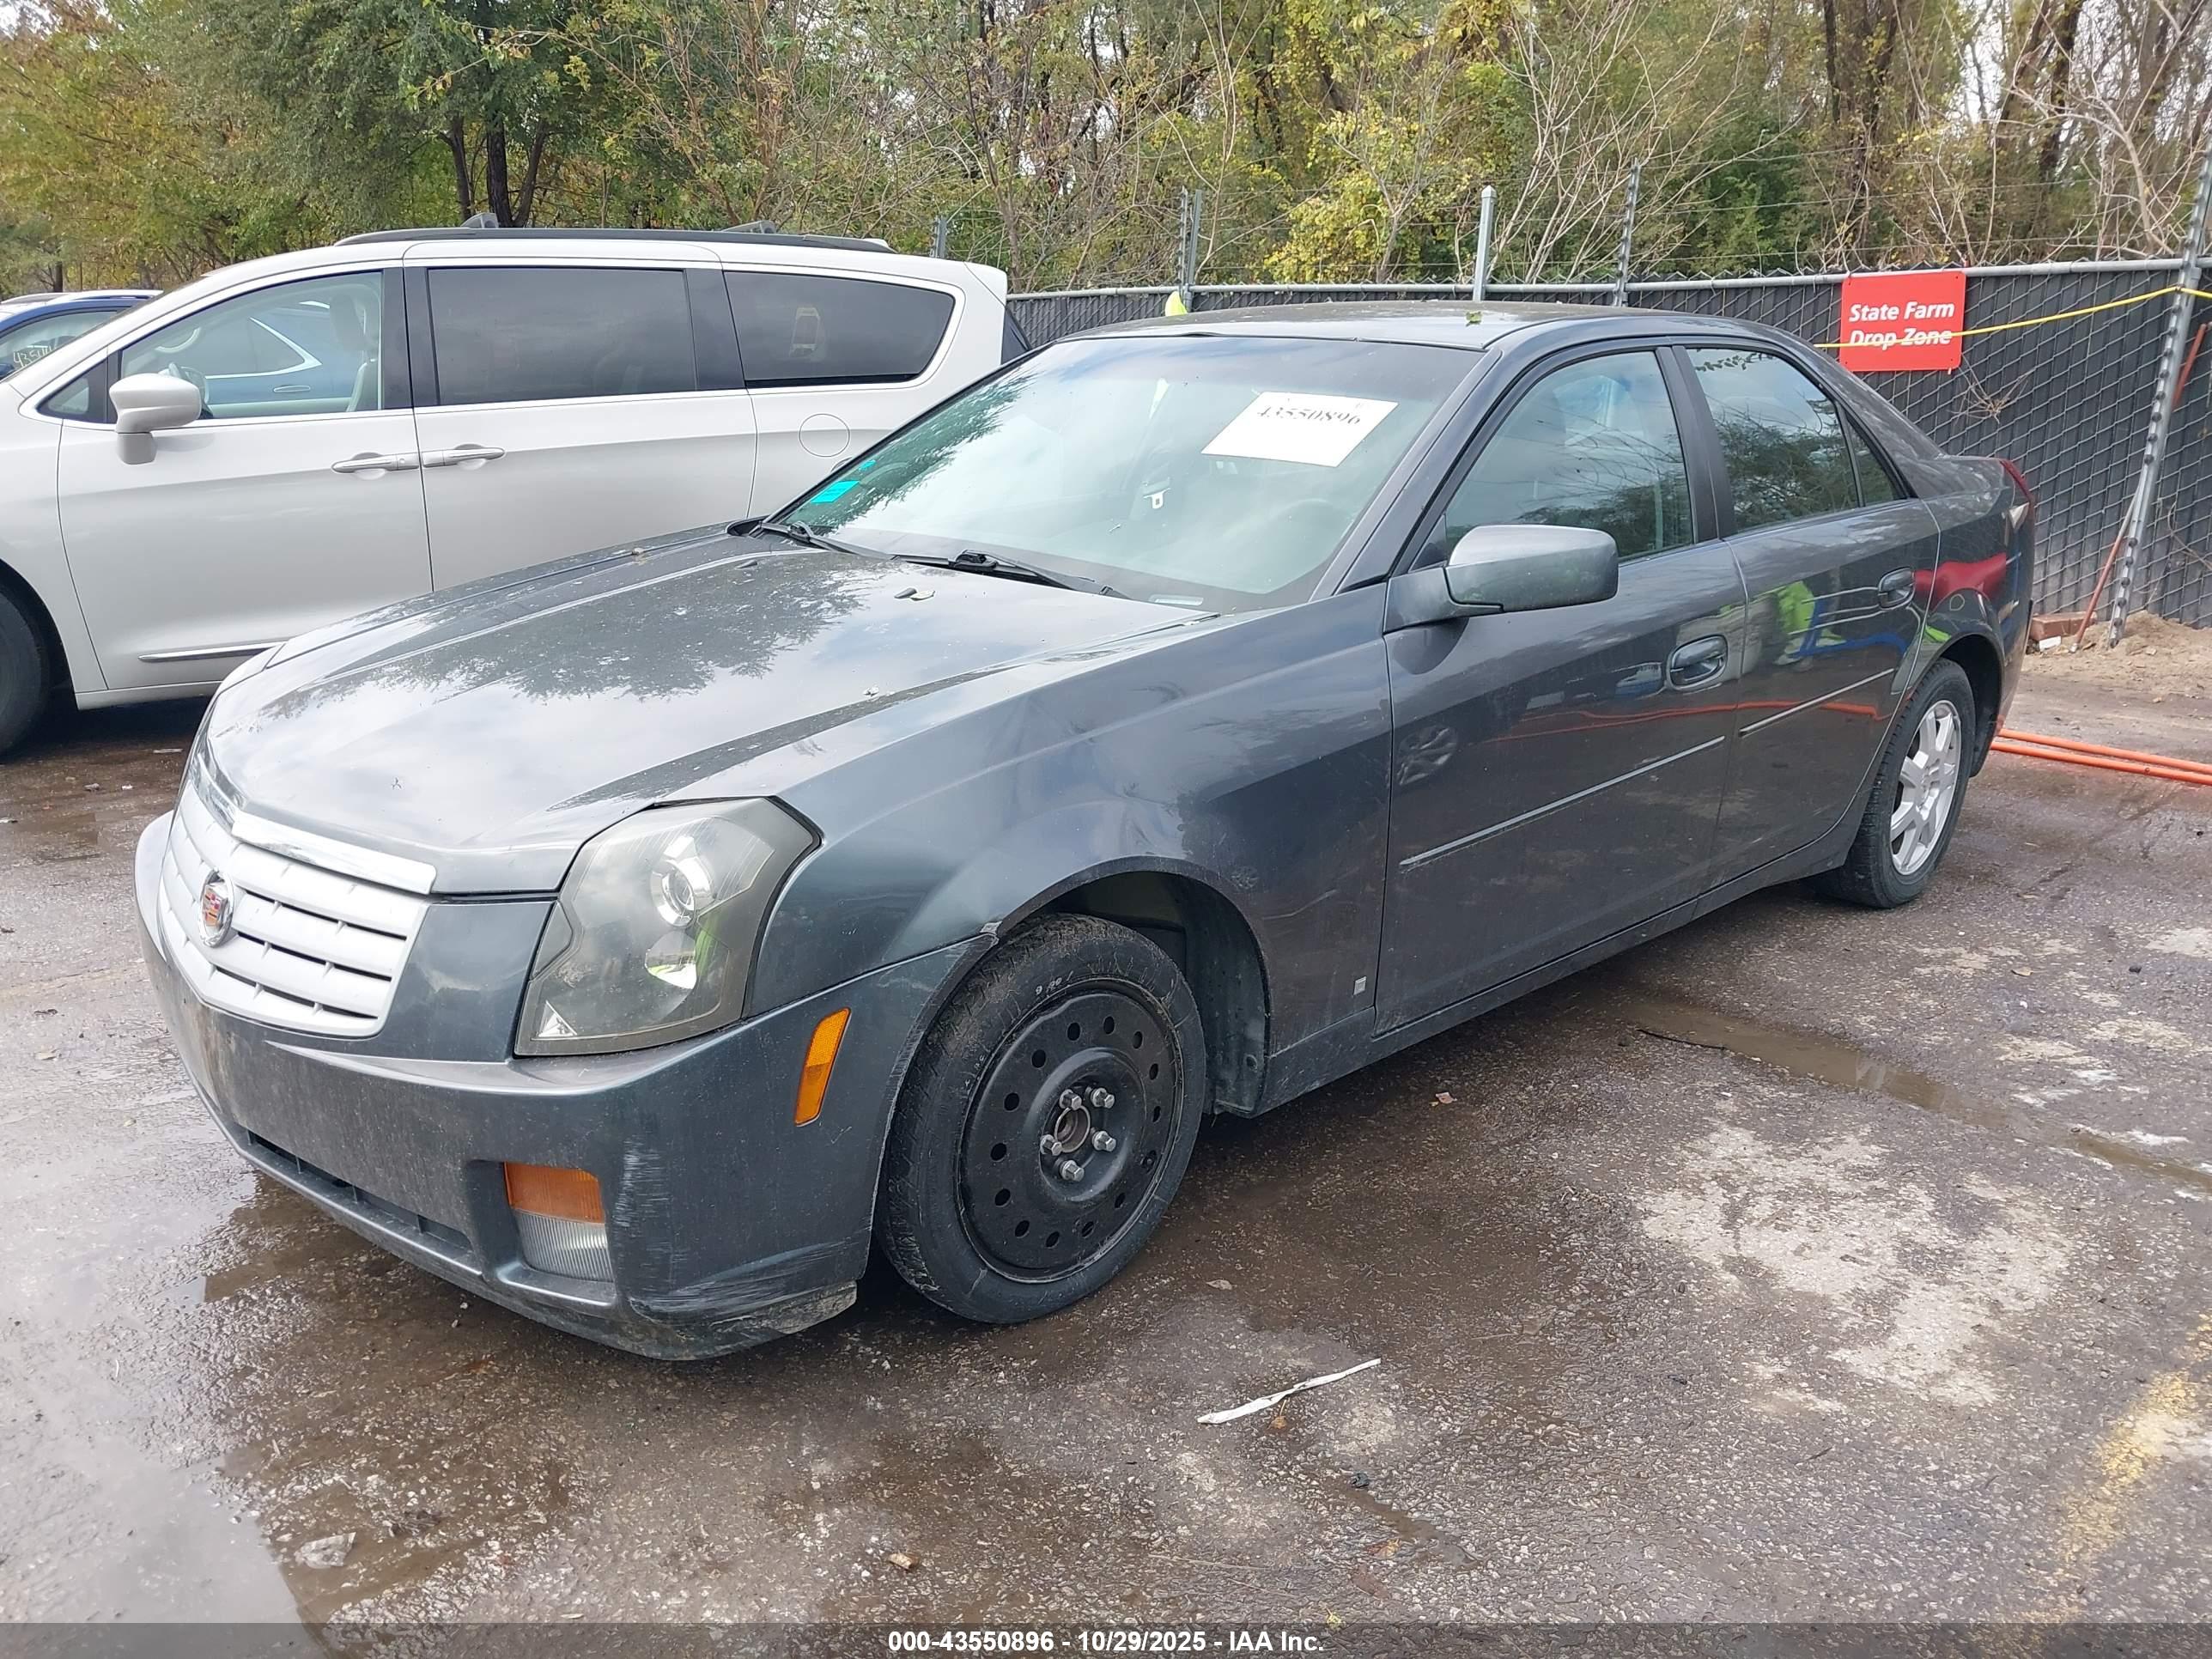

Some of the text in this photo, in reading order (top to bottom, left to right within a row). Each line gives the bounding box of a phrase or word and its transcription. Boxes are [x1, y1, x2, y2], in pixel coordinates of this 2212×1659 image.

[1849, 301, 1955, 322] State Farm
[1850, 328, 1952, 350] Drop Zone
